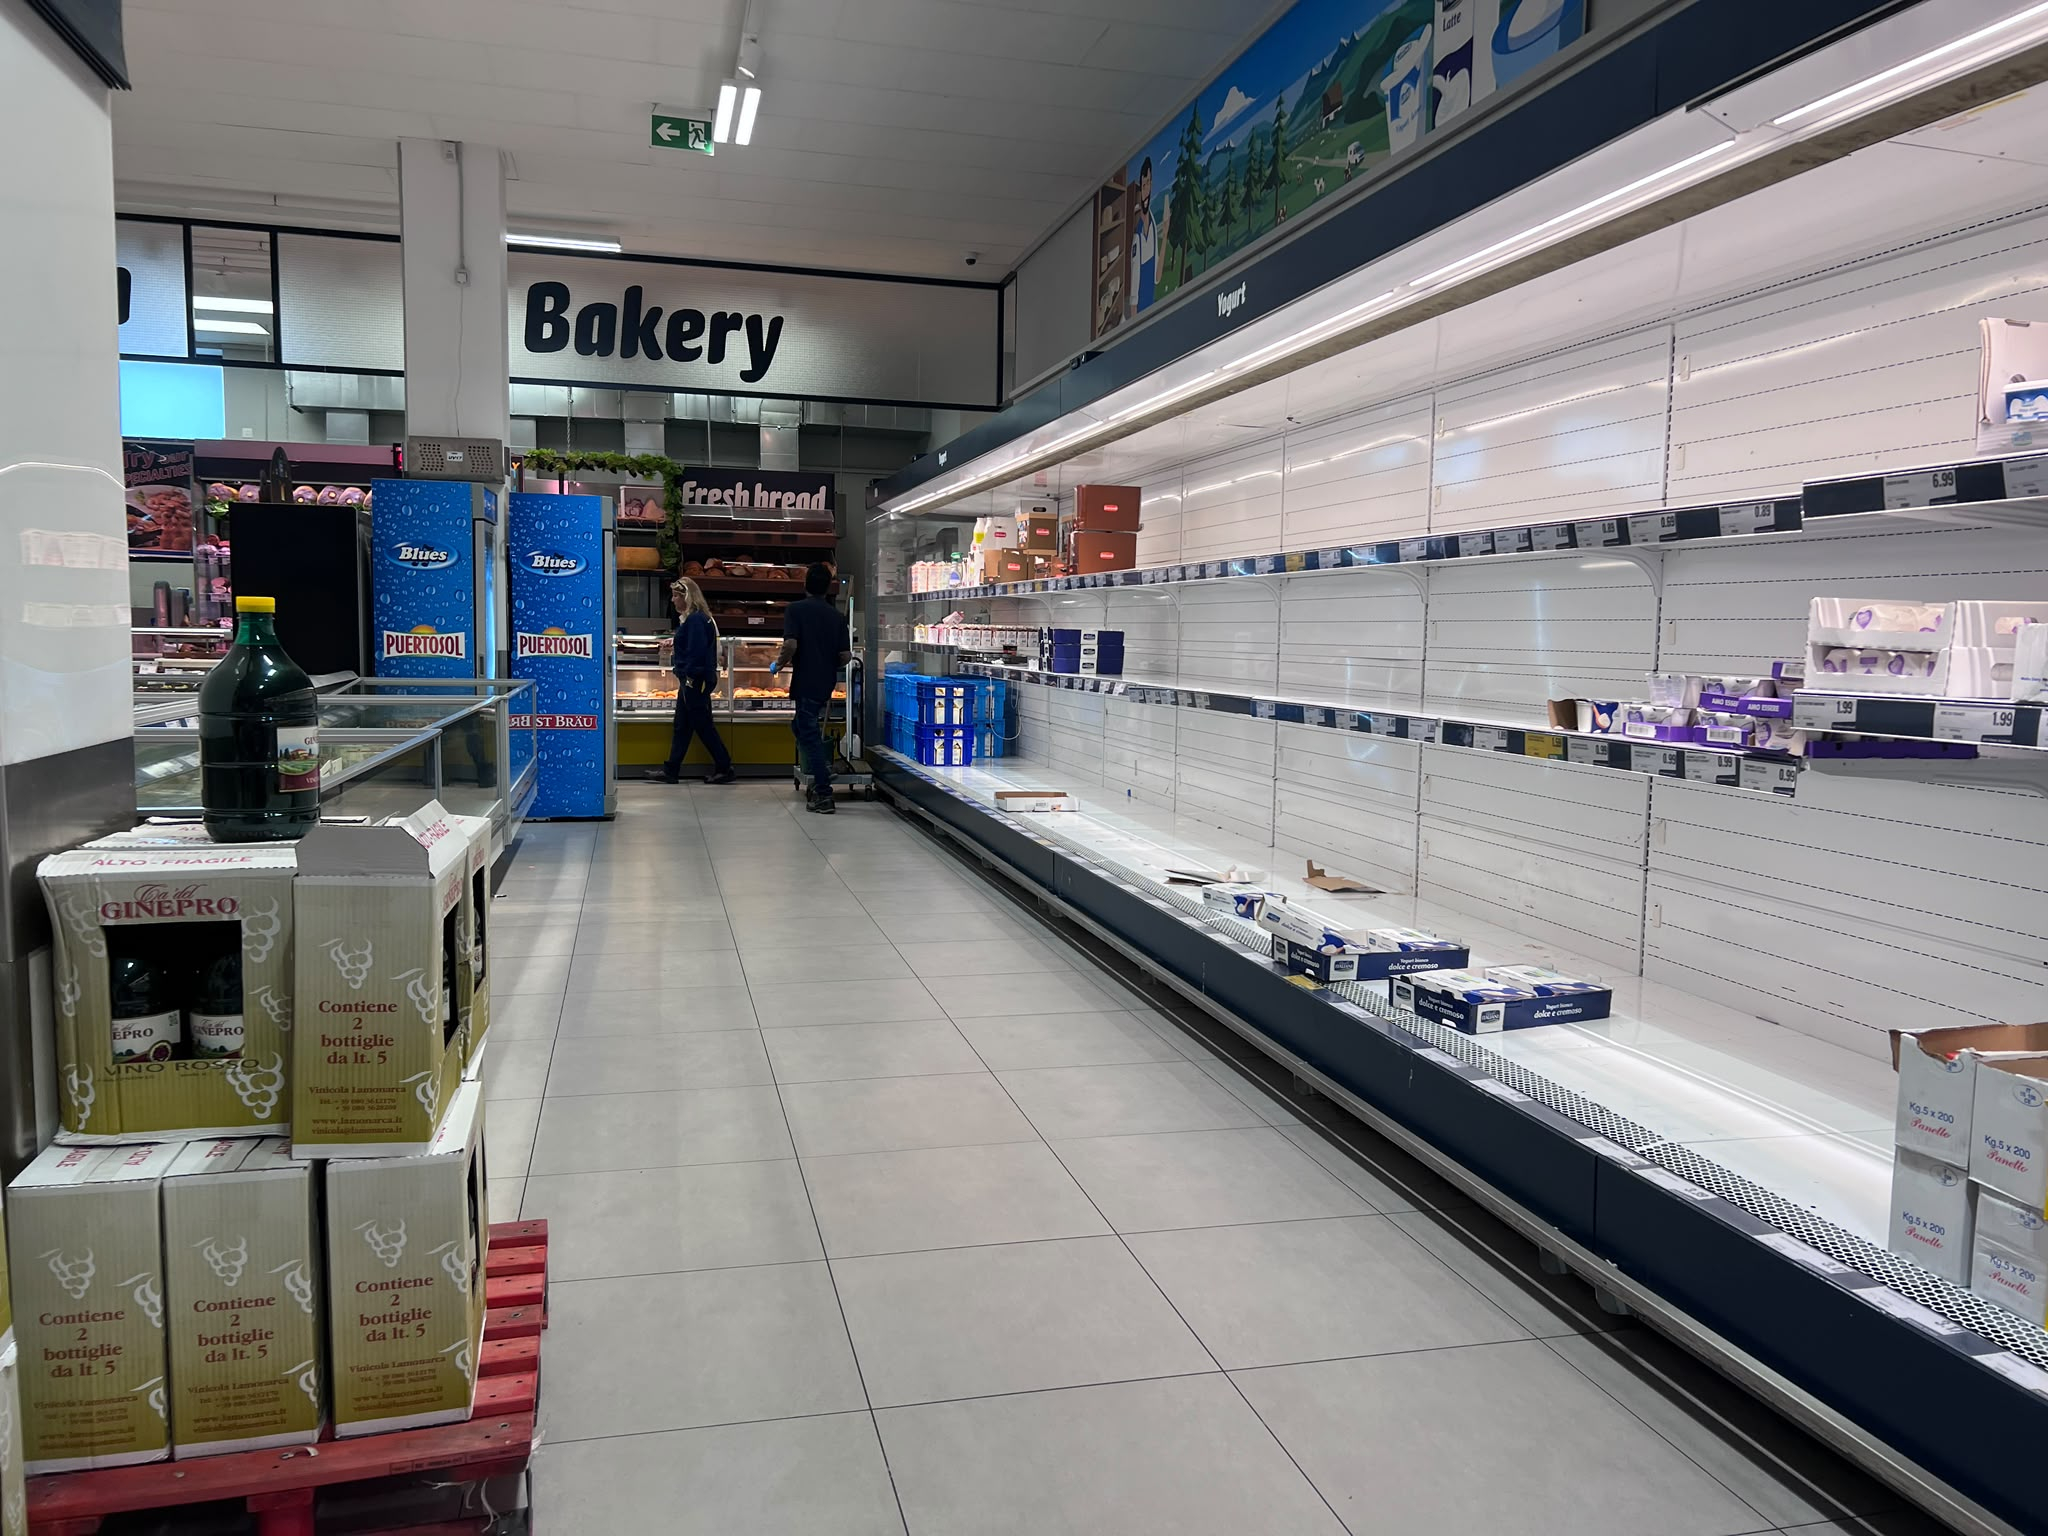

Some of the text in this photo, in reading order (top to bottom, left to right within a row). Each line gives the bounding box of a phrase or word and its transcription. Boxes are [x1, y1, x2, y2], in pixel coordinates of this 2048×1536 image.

[1442, 11, 1461, 31] Latte
[1217, 281, 1246, 317] Yogurt
[524, 281, 784, 382] Bakery
[125, 463, 192, 483] PECIALTIES
[1932, 471, 1954, 488] 6.99
[682, 480, 827, 509] Fresh bread
[399, 547, 447, 562] Blues
[532, 554, 576, 569] Blues
[386, 634, 463, 656] PUERTOSOL
[519, 635, 590, 657] PUERTOSOL
[1836, 701, 1853, 714] 1.99
[536, 715, 593, 727] ST BRÄU
[1992, 711, 2013, 727] 1.99
[1662, 753, 1677, 765] 0.99
[1718, 756, 1733, 768] 0.99
[1779, 769, 1795, 782] 0.99
[91, 858, 147, 866] ALTO
[162, 856, 254, 866] FRAGILE
[101, 897, 239, 920] GINEPRO
[318, 1000, 398, 1013] Contiene
[1418, 998, 1434, 1010] dolce
[1439, 1006, 1464, 1020] cremoso
[1534, 1009, 1551, 1018] dolce
[1556, 1007, 1582, 1016] cremoso
[352, 1017, 363, 1030] 2
[112, 1028, 154, 1041] EPRO
[321, 1034, 394, 1050] bottiglie
[327, 1051, 387, 1065] da lt. 5
[104, 1058, 260, 1076] VINO ROSSO
[352, 1086, 406, 1094] Lamonarca
[312, 1116, 403, 1125] www.lamonarca.it
[1909, 1101, 1954, 1124] Kg.5 x 200
[1984, 1135, 2031, 1159] Kg.5 x 200
[1902, 1211, 1921, 1226] Kg.5
[1929, 1222, 1945, 1236] 200
[1990, 1255, 2009, 1270] Kg.5
[2018, 1267, 2036, 1282] 200
[355, 1276, 434, 1293] Contiene
[193, 1296, 276, 1312] Contiene
[391, 1294, 400, 1306] 2
[40, 1310, 125, 1326] Contiene
[230, 1314, 240, 1327] 2
[360, 1308, 432, 1326] bottiglie
[77, 1328, 88, 1341] 2
[197, 1329, 274, 1346] bottiglie
[366, 1324, 426, 1342] da lt. 5
[43, 1343, 123, 1361] bottiglie
[205, 1345, 268, 1363] da lt. 5
[50, 1360, 116, 1378] da lt. 5
